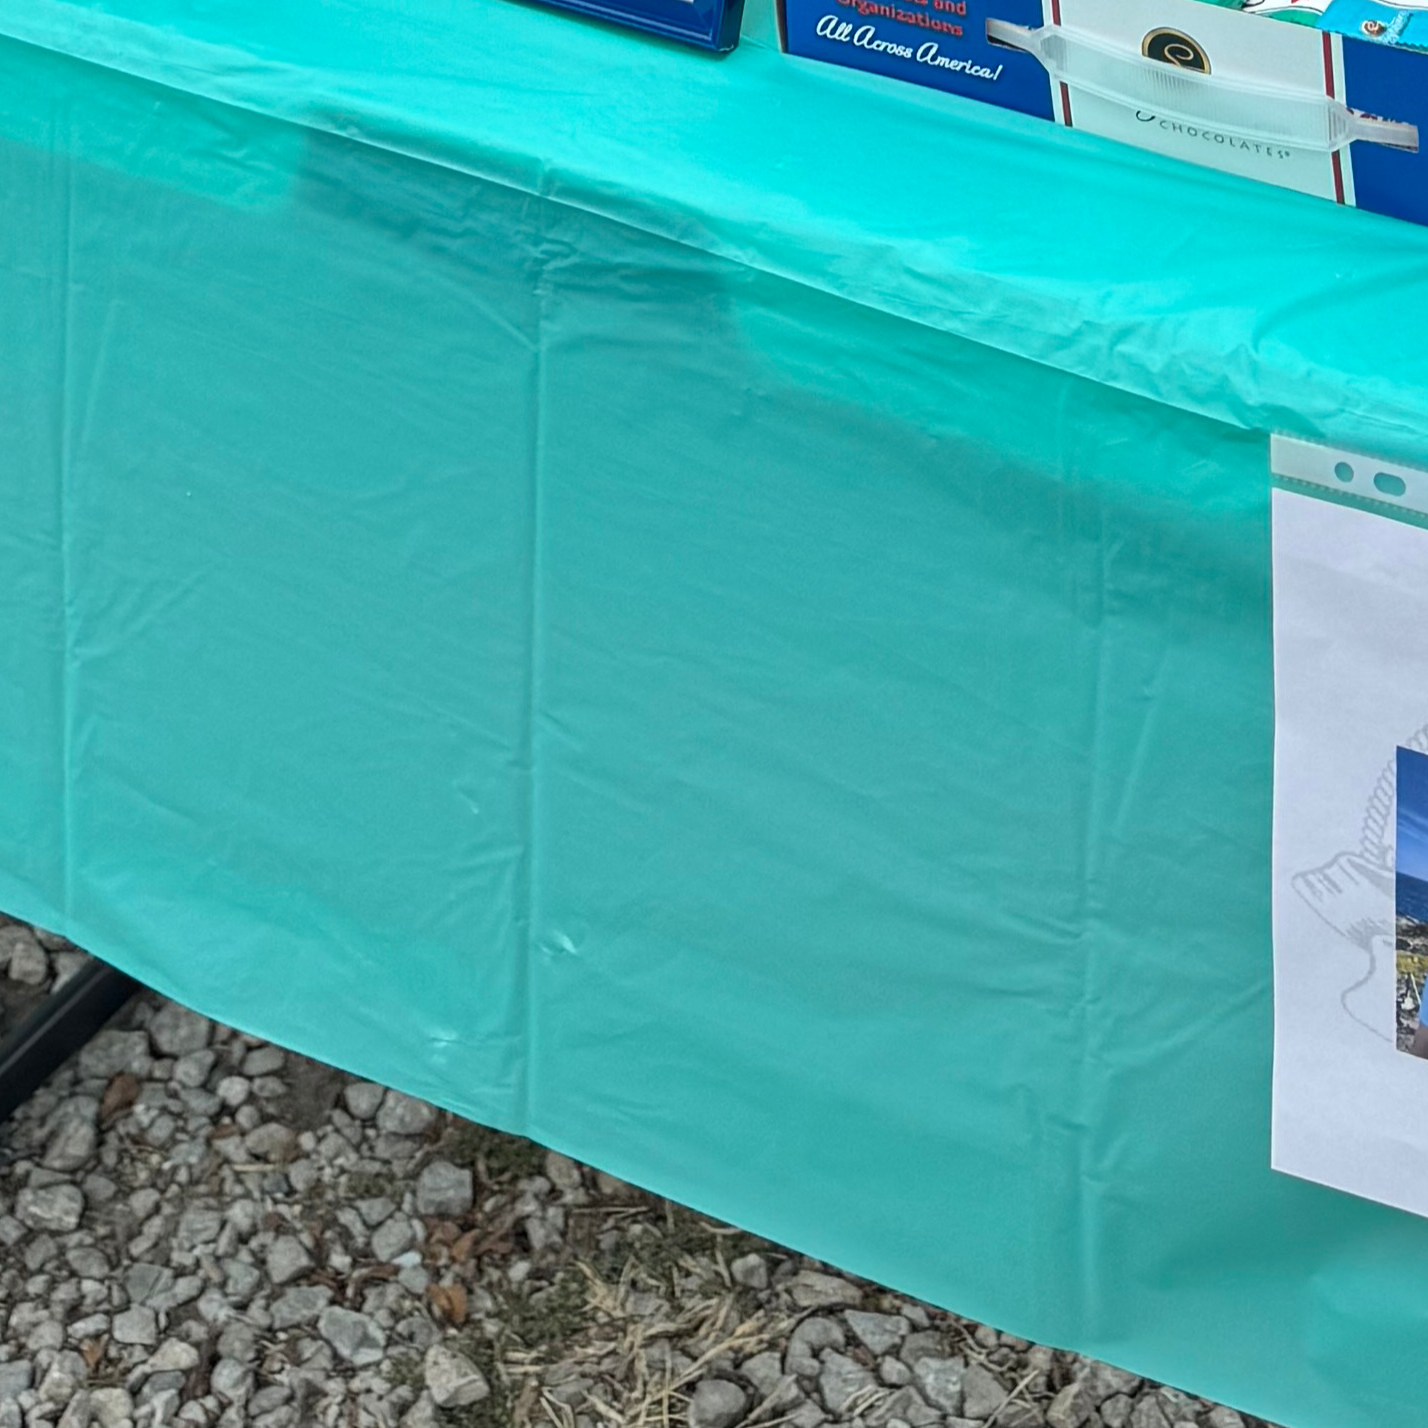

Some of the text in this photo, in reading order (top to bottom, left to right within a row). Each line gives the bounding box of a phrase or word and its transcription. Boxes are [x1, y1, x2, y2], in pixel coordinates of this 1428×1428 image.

[816, 14, 1004, 81] All Across America!
